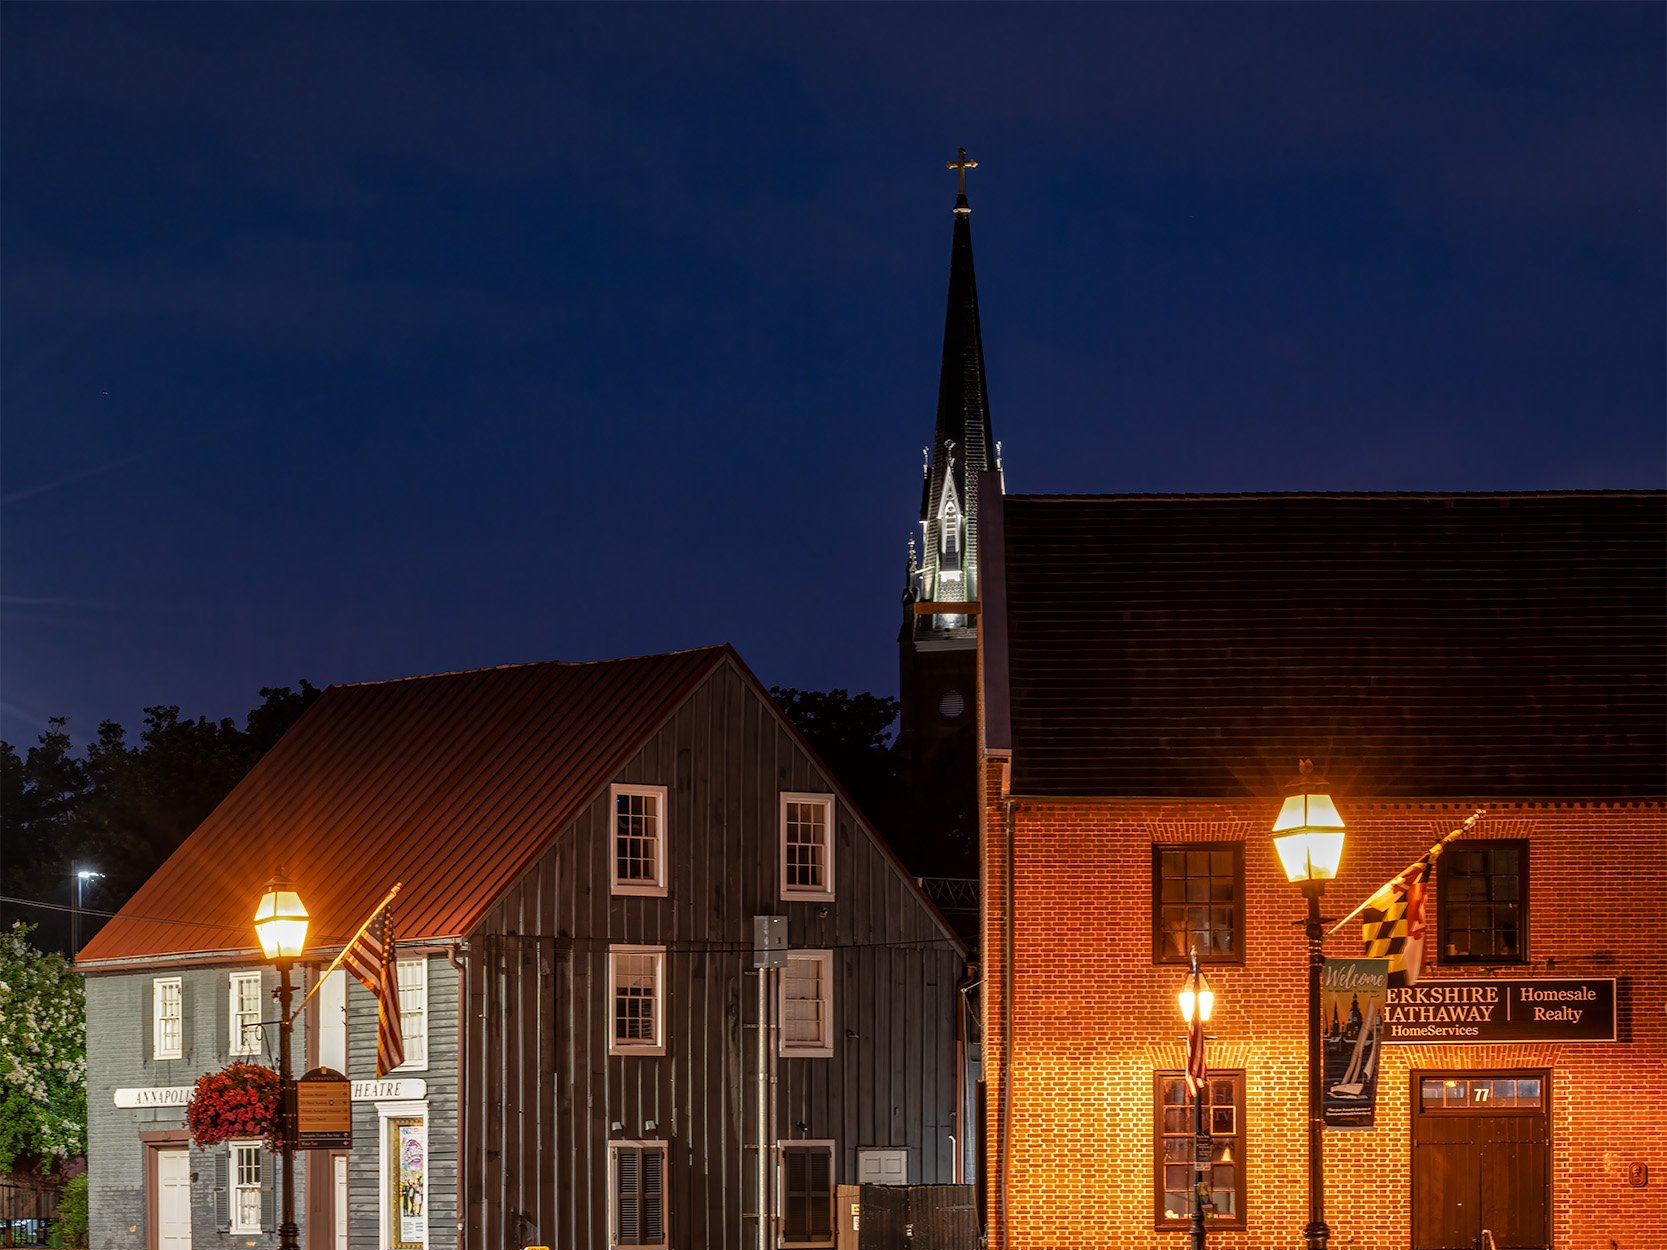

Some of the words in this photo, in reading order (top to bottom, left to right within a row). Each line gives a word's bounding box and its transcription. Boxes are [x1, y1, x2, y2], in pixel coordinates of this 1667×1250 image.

[1326, 964, 1384, 989] Welcome
[1385, 987, 1499, 1004] ERKSHIRE
[1520, 986, 1596, 1001] Homesale
[1533, 1006, 1583, 1023] Realty
[1391, 1024, 1479, 1037] HomeServices
[351, 1082, 401, 1097] HEATRE
[1473, 1088, 1490, 1102] 77
